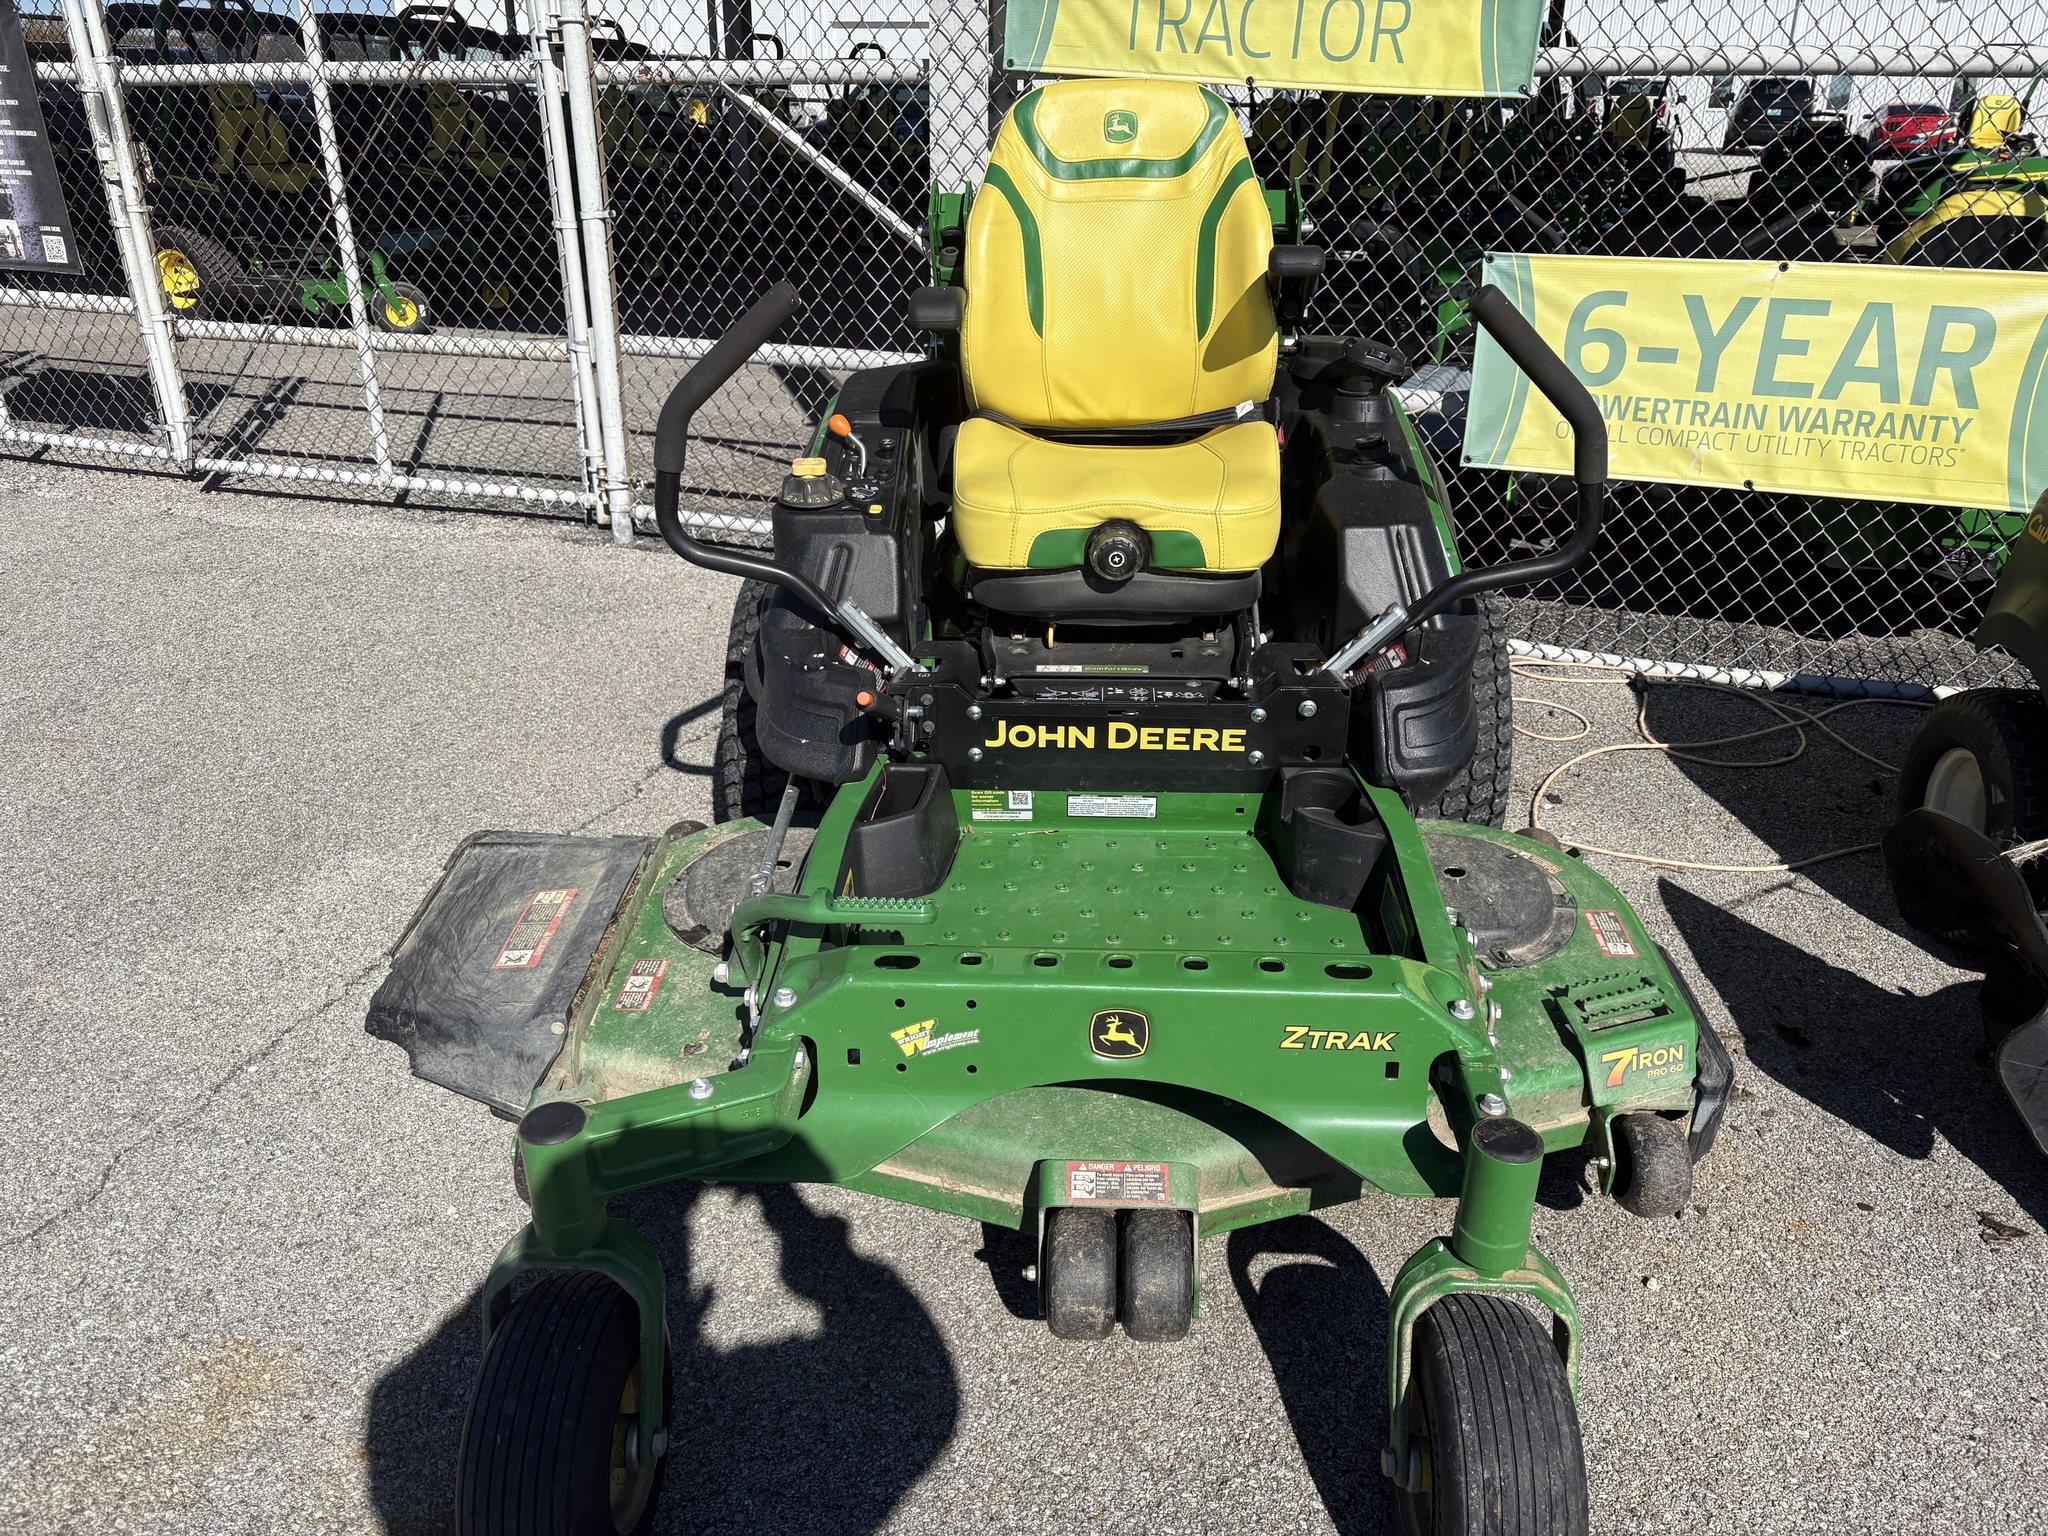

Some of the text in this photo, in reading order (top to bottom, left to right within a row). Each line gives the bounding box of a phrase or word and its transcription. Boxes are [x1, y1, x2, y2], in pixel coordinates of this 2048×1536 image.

[1563, 290, 1998, 410] 6-YEAR
[1588, 393, 1975, 445] WERTRAIN WARRANTY
[1555, 420, 1575, 440] O
[1607, 424, 1630, 444] LL
[1636, 425, 1740, 452] COMPACT
[1746, 433, 1833, 458] UTILITY
[985, 720, 1248, 752] JOHN DEERE
[897, 1029, 931, 1046] WRIGHT
[923, 1029, 980, 1050] Implement
[1647, 1063, 1684, 1079] PRO 60
[1088, 1163, 1161, 1172] DANGER PELIGRO
